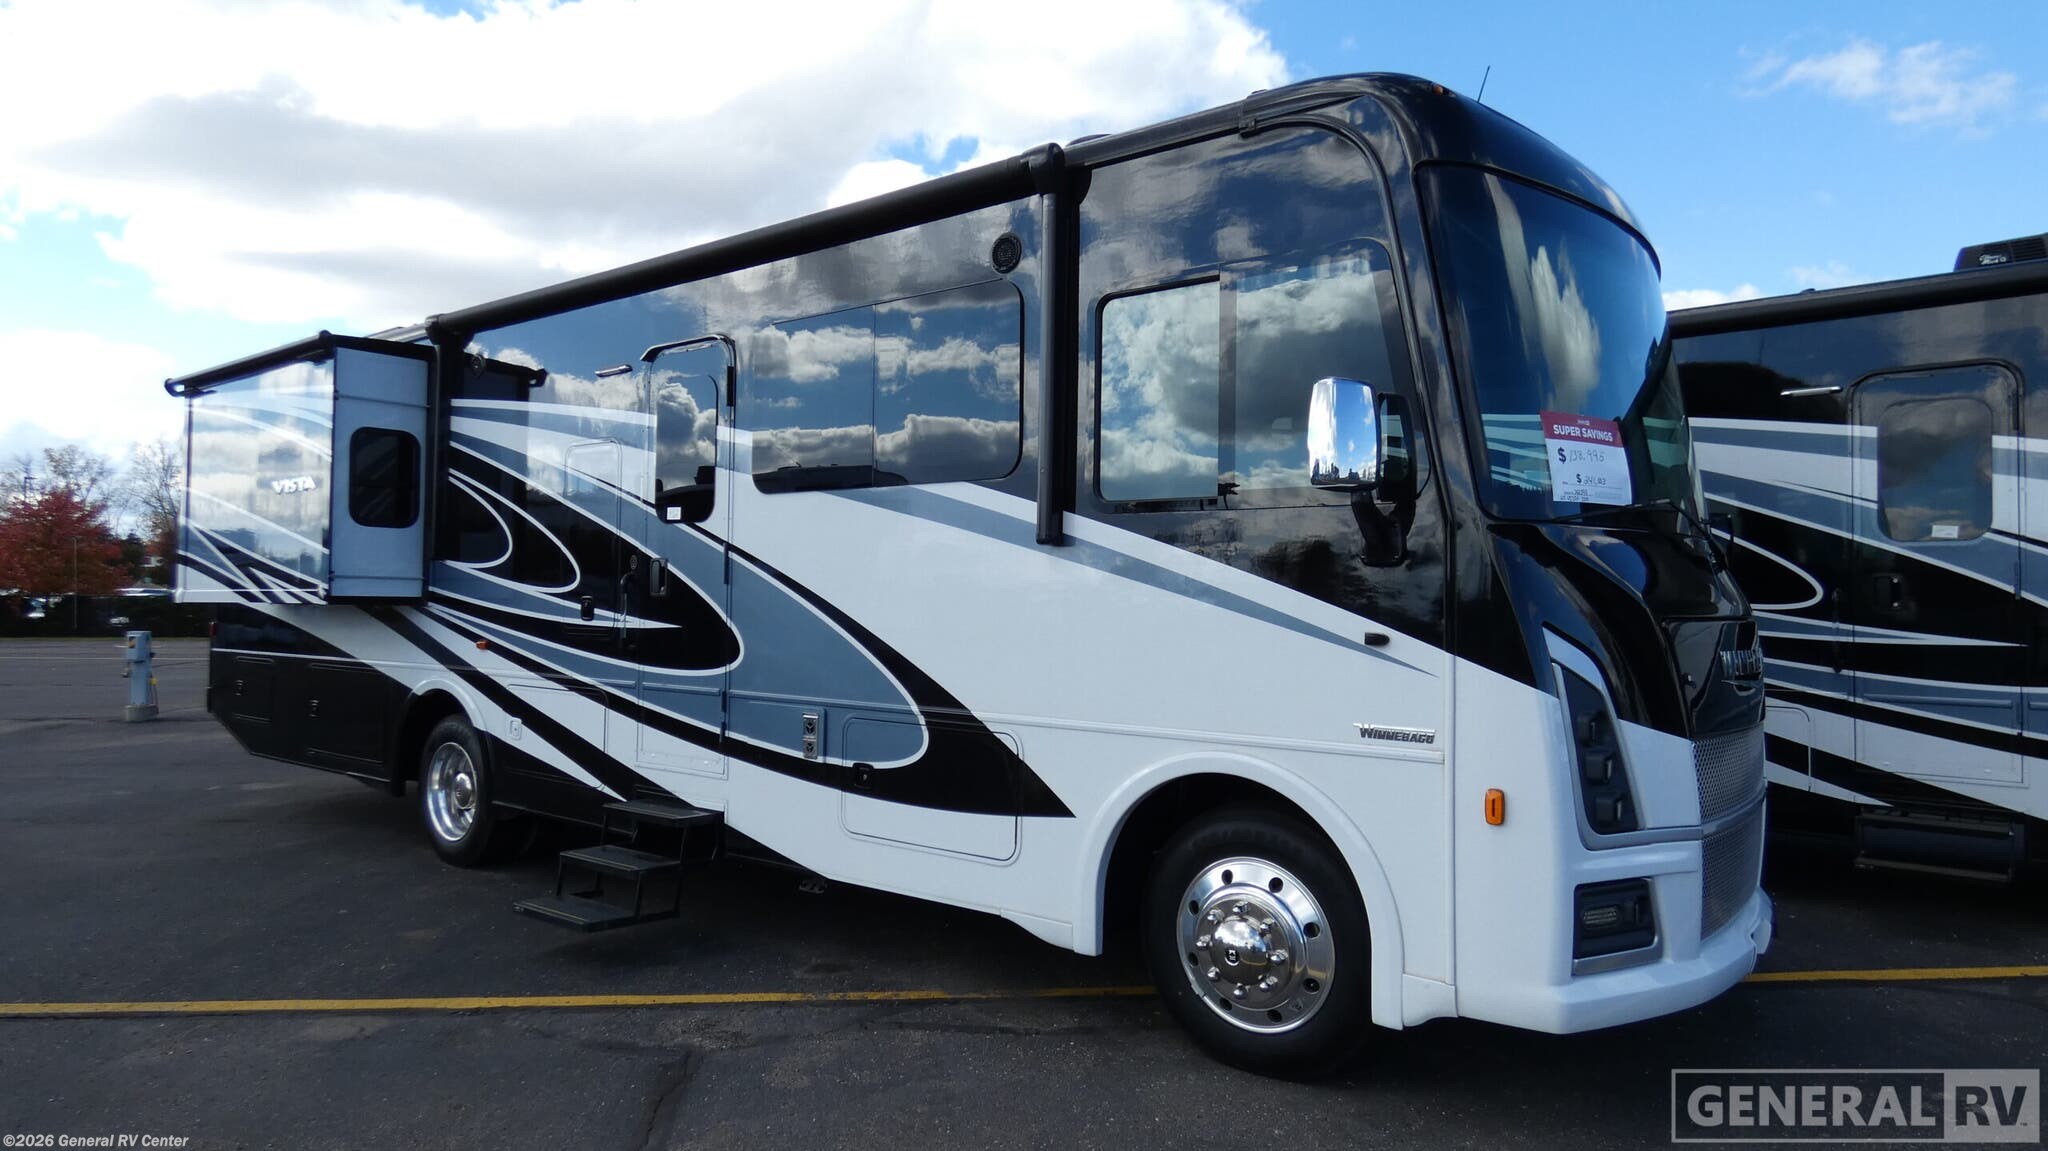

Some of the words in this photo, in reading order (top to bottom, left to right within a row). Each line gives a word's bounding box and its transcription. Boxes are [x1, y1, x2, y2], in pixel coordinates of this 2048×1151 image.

[1552, 424, 1581, 437] SUPER
[1581, 427, 1614, 442] SAVINGS
[1557, 447, 1567, 464] $
[271, 476, 317, 494] VISTA
[1357, 723, 1437, 744] WINNEBAGO
